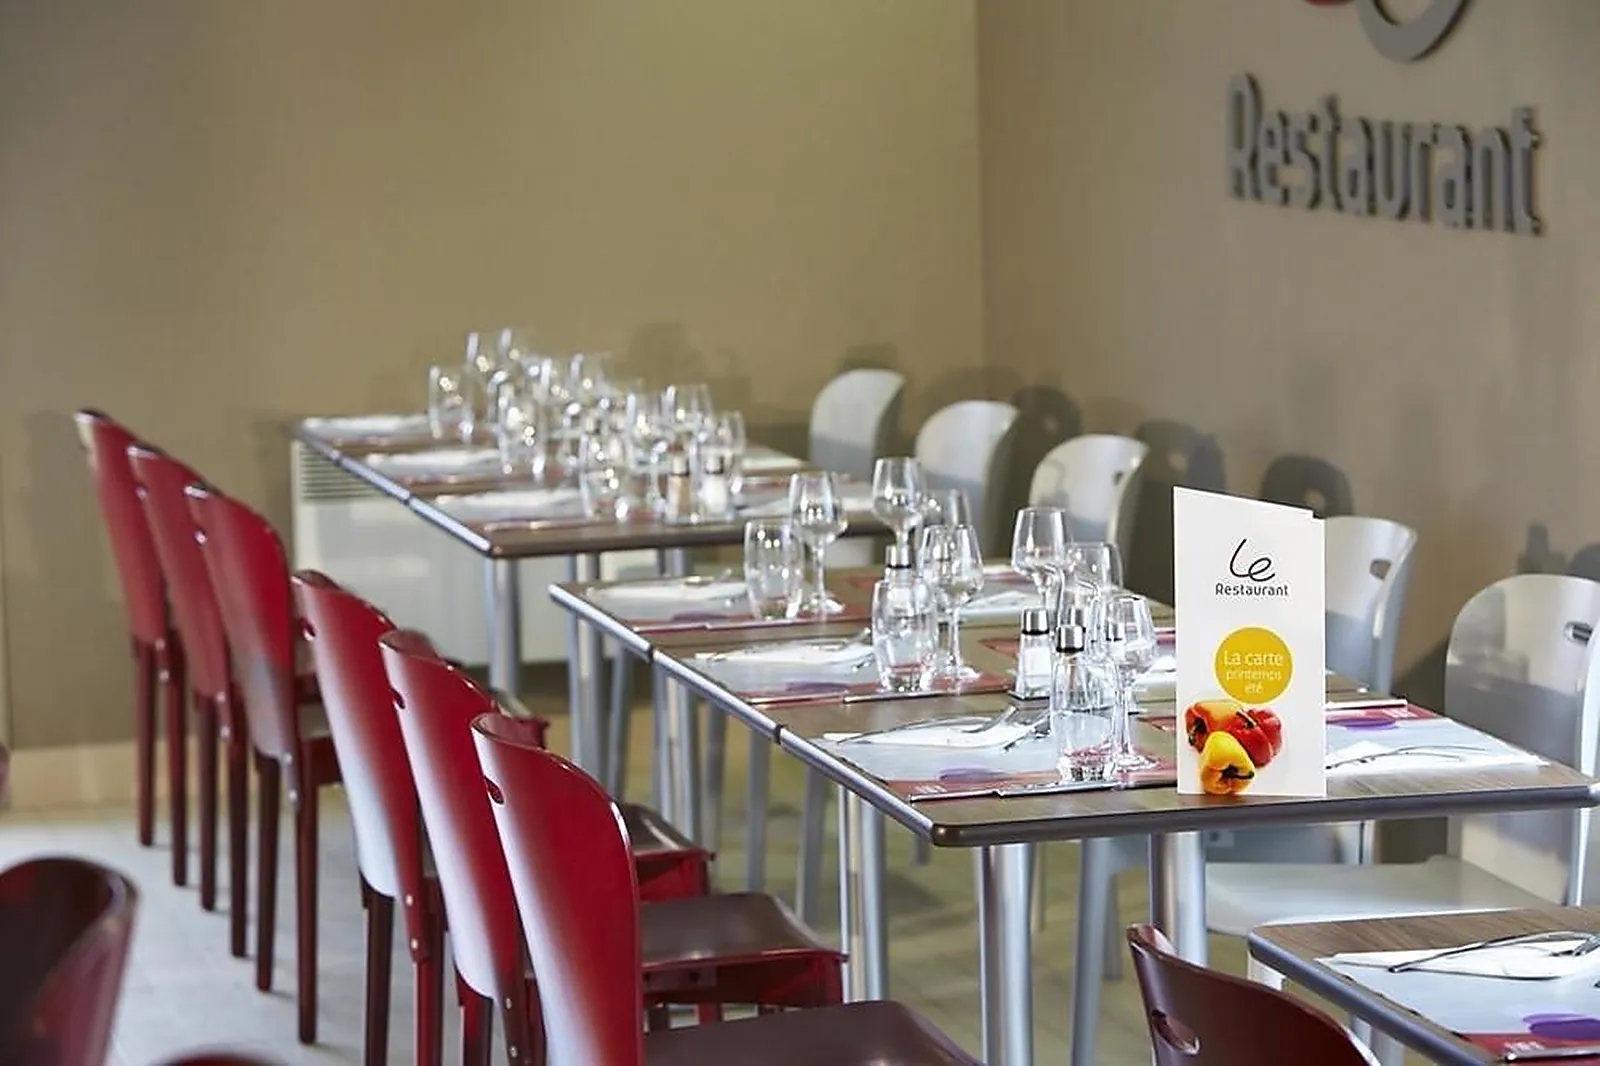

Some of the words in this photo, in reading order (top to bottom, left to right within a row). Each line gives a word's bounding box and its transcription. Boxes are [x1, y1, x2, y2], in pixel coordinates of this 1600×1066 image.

[1228, 73, 1546, 237] Restaurant
[1229, 538, 1276, 582] Le
[1215, 583, 1288, 597] Restaurant
[1223, 650, 1242, 666] La
[1244, 652, 1284, 667] carte
[1226, 670, 1282, 681] printemps
